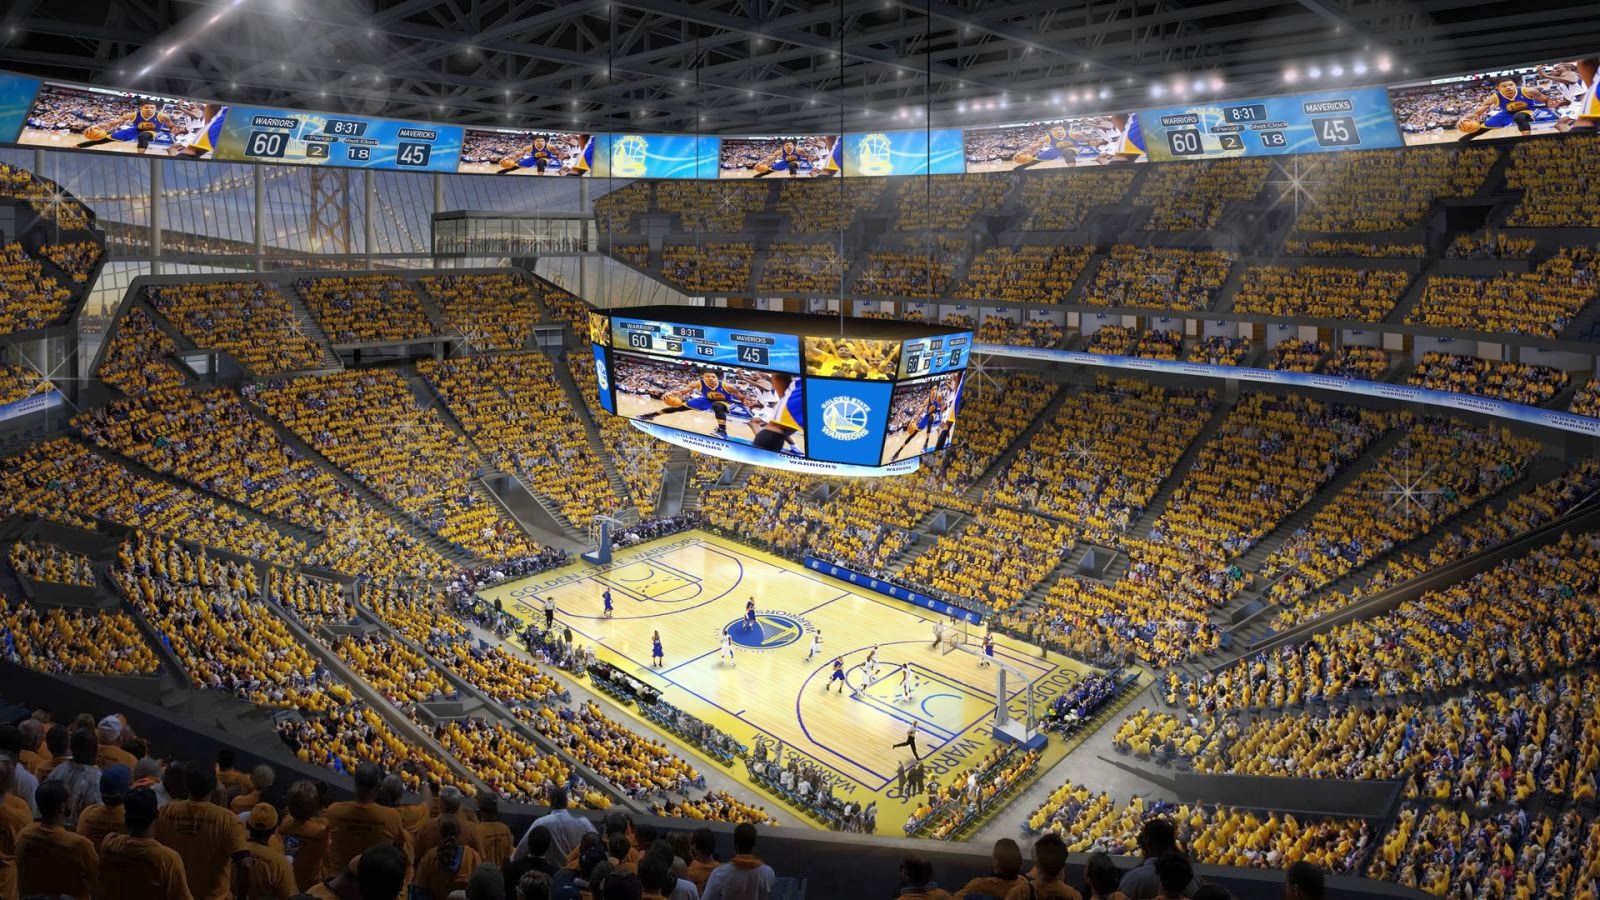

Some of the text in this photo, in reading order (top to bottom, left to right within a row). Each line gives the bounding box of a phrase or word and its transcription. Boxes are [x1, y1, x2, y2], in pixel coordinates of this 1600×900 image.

[1305, 101, 1351, 113] MAVERICKS
[1232, 107, 1256, 120] 8:31
[254, 117, 295, 128] WARRIORS
[1162, 115, 1198, 125] WARRIORS
[334, 122, 358, 135] 8:31
[399, 129, 435, 139] MAVERICKS
[1323, 120, 1350, 142] 45
[253, 133, 280, 156] 60
[1172, 133, 1197, 153] 60
[1225, 137, 1237, 148] 2
[1262, 134, 1285, 145] 18
[311, 146, 322, 156] 2
[349, 148, 369, 158] 18
[400, 145, 425, 164] 45
[626, 323, 655, 332] WARRIORS
[680, 328, 696, 337] 8:31
[631, 334, 647, 347] 60
[736, 335, 767, 344] MAVERICKS
[697, 345, 713, 355] 18
[743, 346, 760, 363] 45
[907, 358, 918, 372] 60
[821, 396, 872, 413] GOLDEN STATE
[1457, 401, 1495, 412] WARRIORS
[1542, 413, 1577, 424] GOLDEN
[1551, 419, 1596, 433] WARRIORS
[821, 426, 869, 441] WARRIORS
[675, 432, 731, 449] GOLDEN STATE
[682, 438, 722, 451] WARRIORS
[789, 460, 838, 470] WARRIORS
[510, 573, 579, 598] GOLDEN
